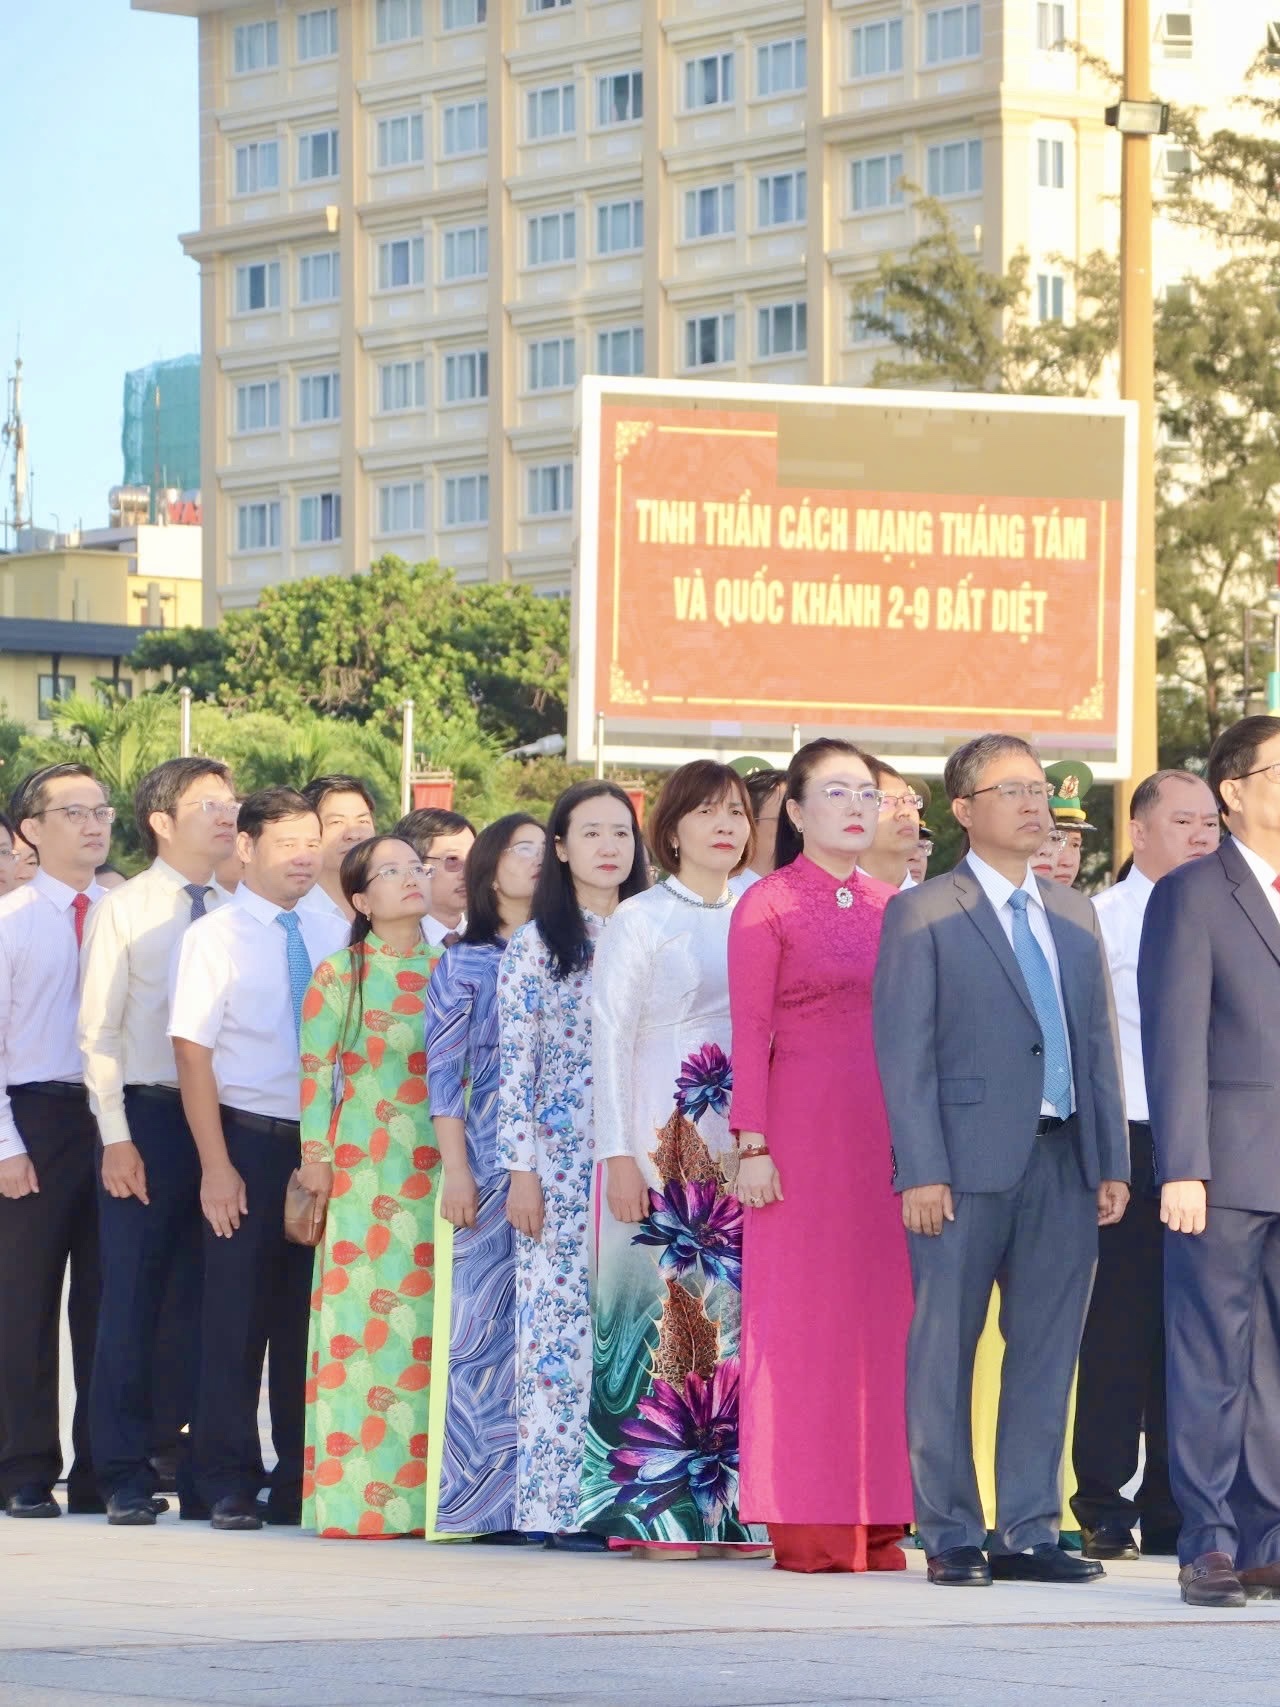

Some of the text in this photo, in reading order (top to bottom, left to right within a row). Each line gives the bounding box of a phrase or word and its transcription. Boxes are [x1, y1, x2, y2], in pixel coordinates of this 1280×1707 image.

[636, 488, 1088, 563] TINH THẦN CÁCH MẠNG THÁNG TÁM
[673, 564, 1049, 644] VÀ QUỐC KHÁNH 2-9 BẤT DIỆT
